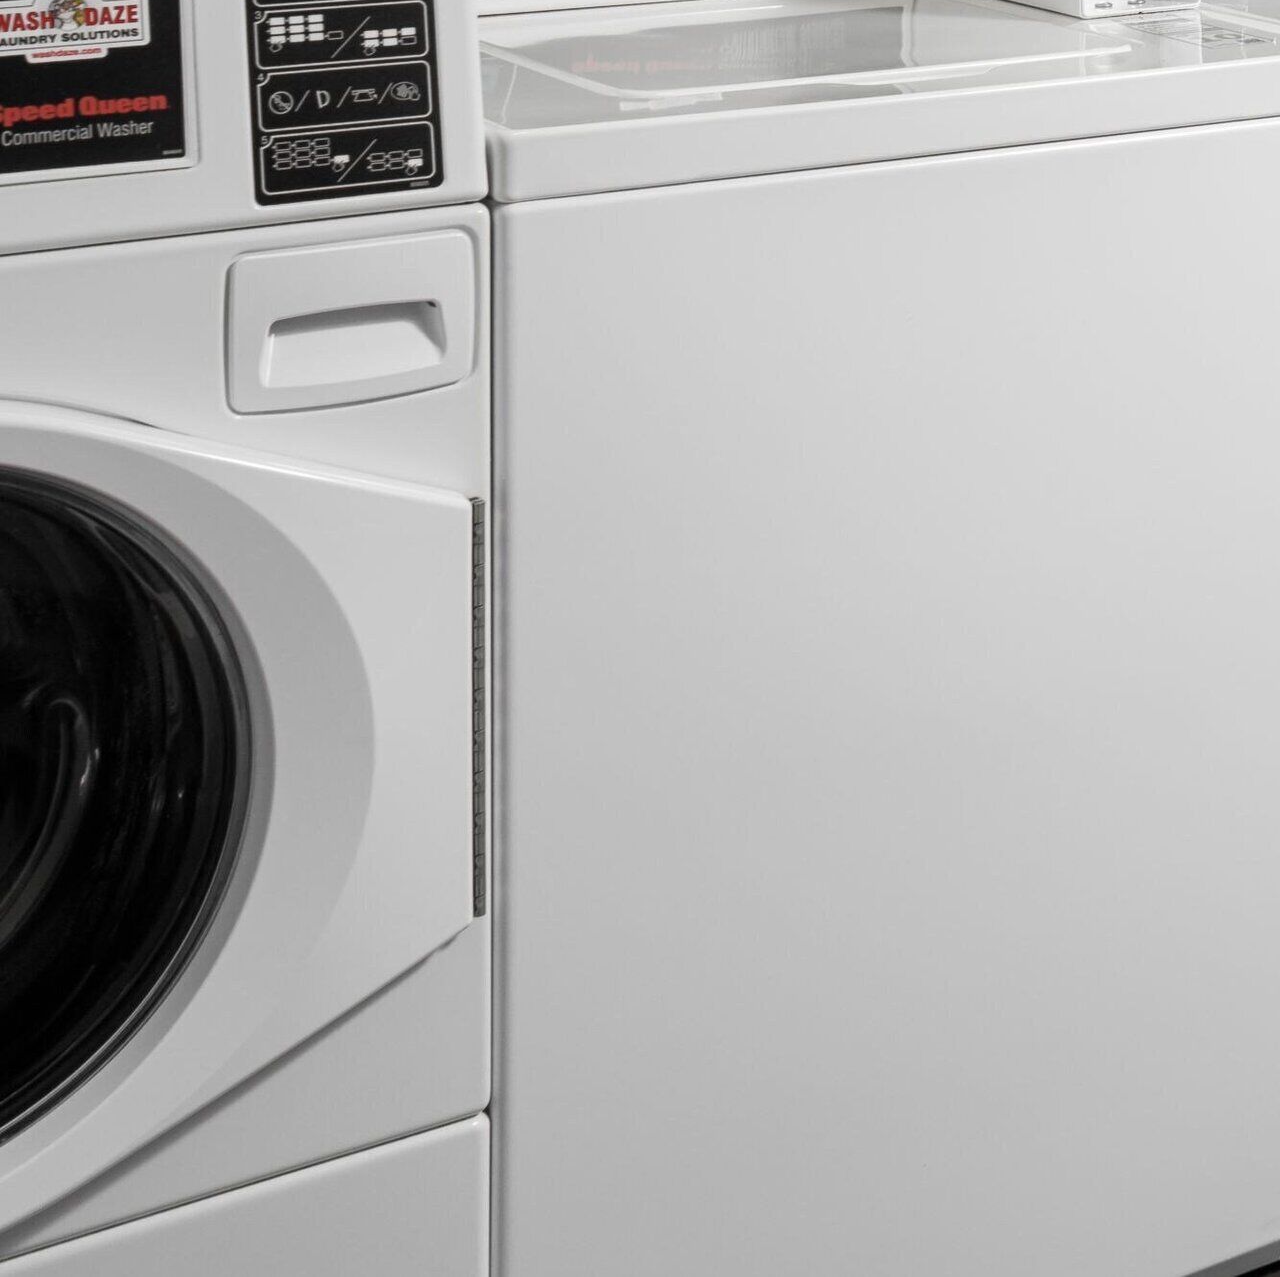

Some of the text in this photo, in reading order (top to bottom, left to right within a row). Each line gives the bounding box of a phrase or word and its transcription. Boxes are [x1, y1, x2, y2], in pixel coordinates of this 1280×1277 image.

[83, 4, 139, 27] DAZE
[254, 11, 262, 20] 3
[0, 28, 139, 48] AUNDRY SOLUTIONS
[32, 47, 102, 59] washdaze.com
[257, 73, 265, 82] 4
[0, 94, 168, 128] peed Queen
[1, 120, 154, 147] Commercial Washer
[260, 135, 268, 144] 5
